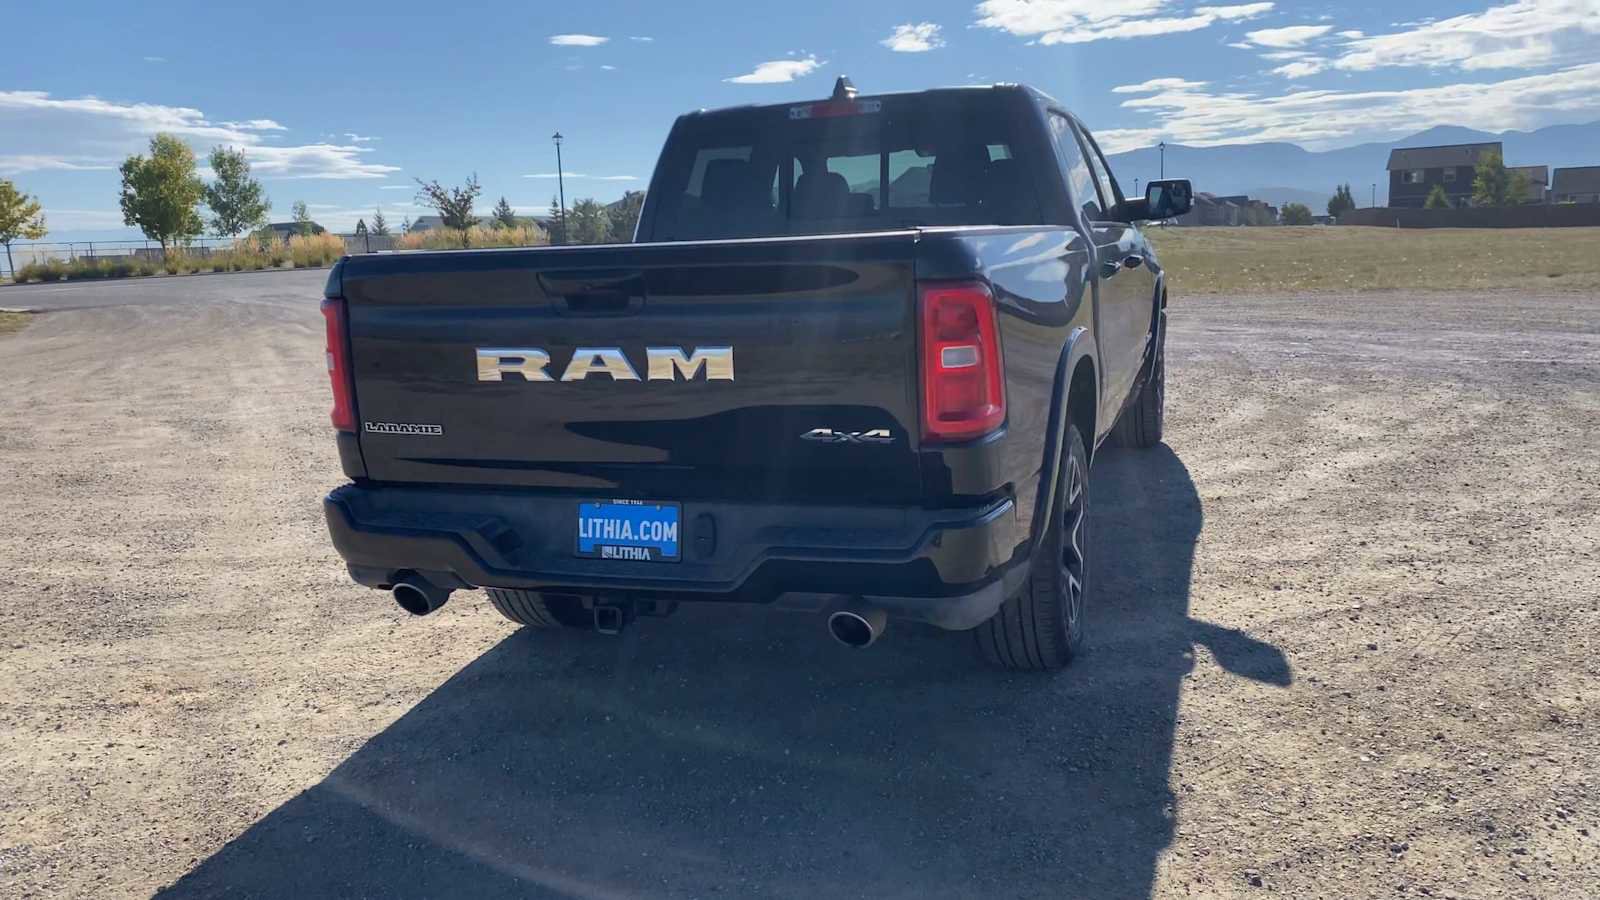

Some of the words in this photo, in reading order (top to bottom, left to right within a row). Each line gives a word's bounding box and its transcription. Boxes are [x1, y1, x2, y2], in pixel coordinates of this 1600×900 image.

[475, 346, 735, 382] RAM
[365, 422, 442, 435] LARAMIE
[579, 518, 677, 542] LITHIA.COM
[612, 546, 651, 560] LITHIA
